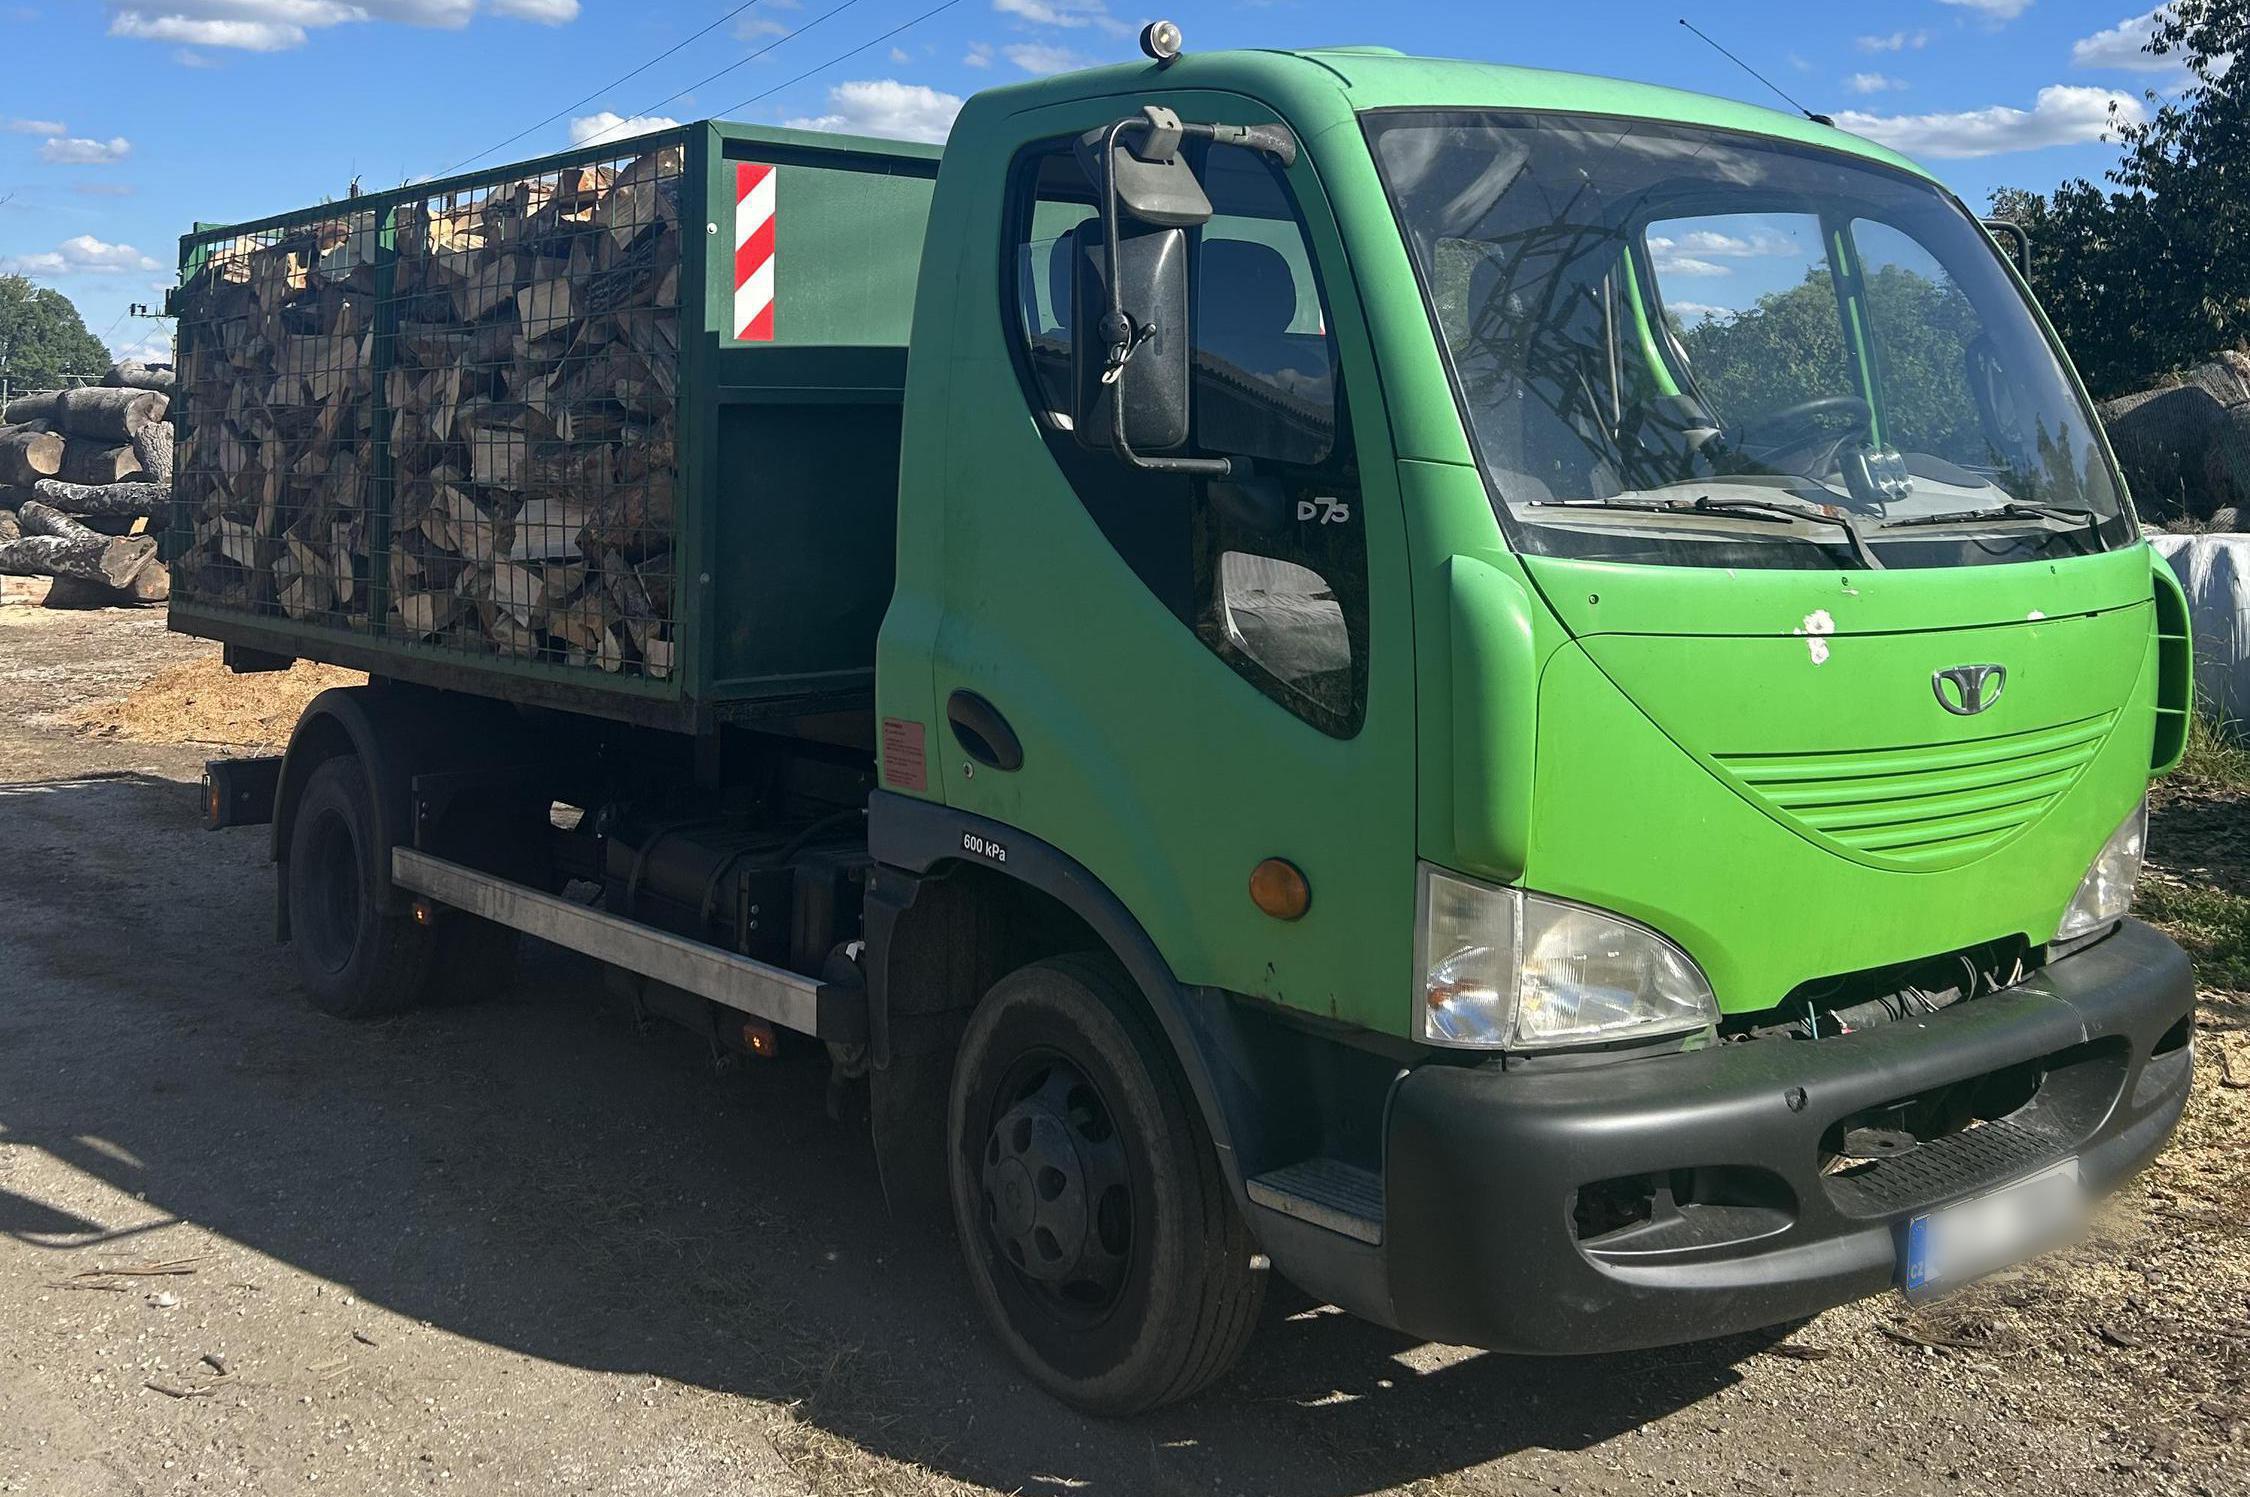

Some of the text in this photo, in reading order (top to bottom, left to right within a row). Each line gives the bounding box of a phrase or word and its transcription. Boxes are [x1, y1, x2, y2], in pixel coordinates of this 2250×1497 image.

[1298, 497, 1350, 525] D75
[964, 834, 1006, 862] 600 kPa
